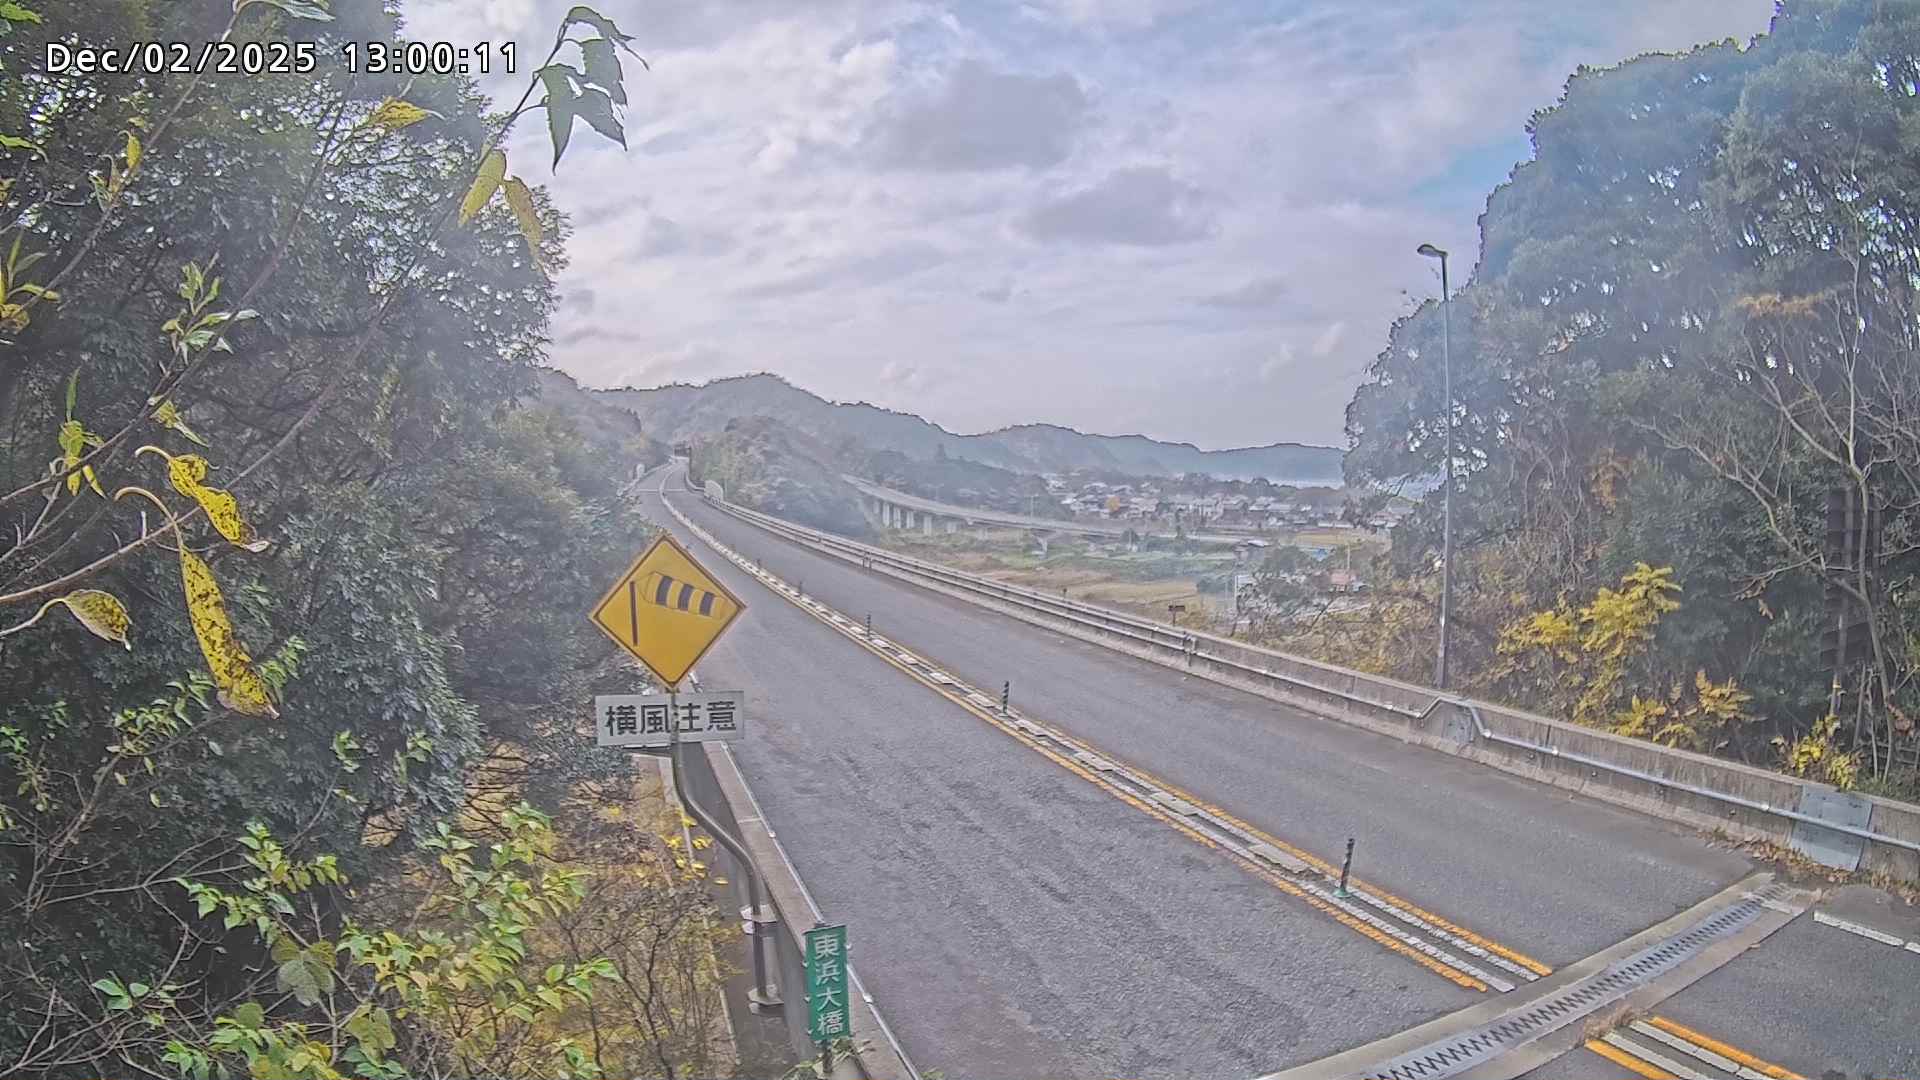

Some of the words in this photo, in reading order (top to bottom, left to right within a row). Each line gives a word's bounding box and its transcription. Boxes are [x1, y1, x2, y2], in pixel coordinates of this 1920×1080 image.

[605, 701, 737, 736] 横風注意
[813, 933, 844, 1036] 東浜大橋
